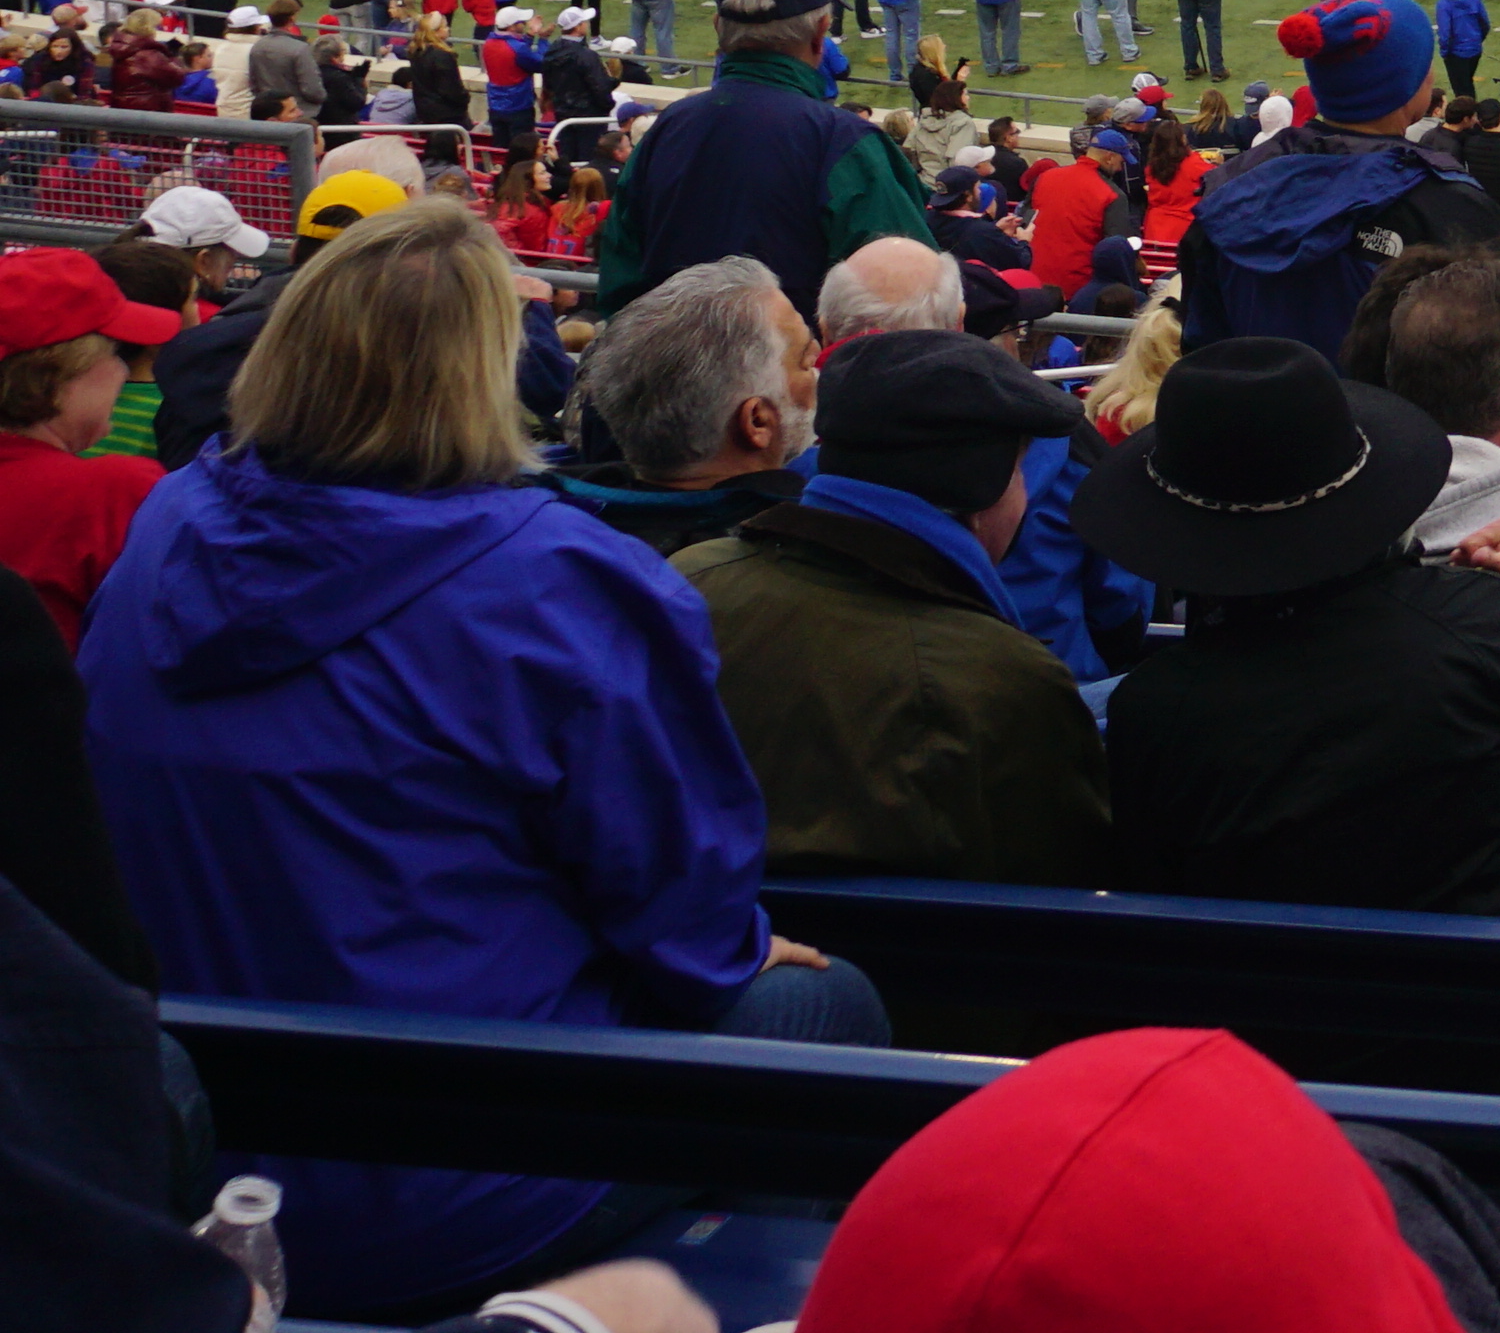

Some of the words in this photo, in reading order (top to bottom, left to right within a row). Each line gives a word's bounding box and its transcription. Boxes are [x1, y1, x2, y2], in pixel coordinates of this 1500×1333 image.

[1356, 230, 1391, 246] NORTH
[1372, 225, 1387, 238] THE
[1362, 238, 1387, 253] FACE
